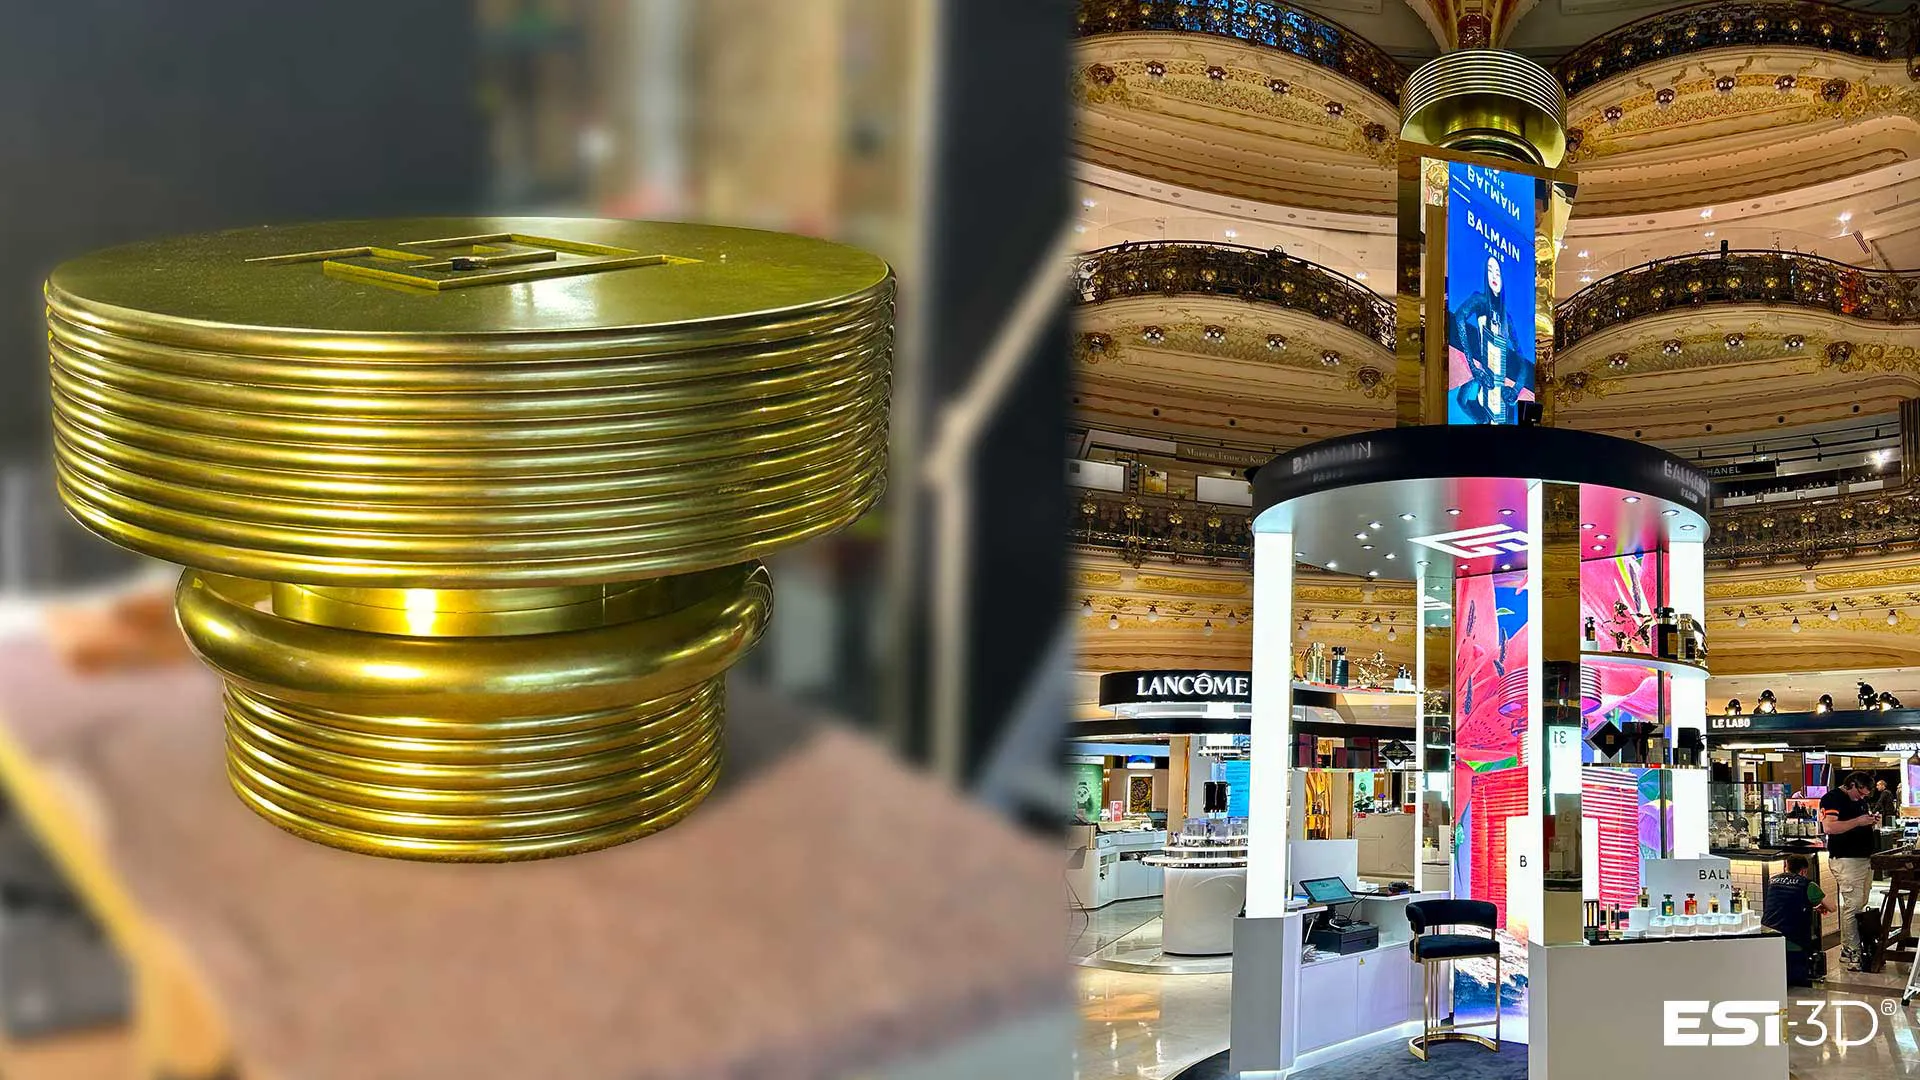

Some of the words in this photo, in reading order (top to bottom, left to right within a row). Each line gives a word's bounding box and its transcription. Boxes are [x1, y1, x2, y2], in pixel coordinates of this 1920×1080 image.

[1467, 209, 1520, 263] BALMAIN
[1484, 242, 1505, 263] PARIS
[1292, 440, 1371, 475] BALMAIN
[1136, 673, 1249, 696] LANCÔME
[1712, 719, 1724, 729] LE
[1726, 718, 1750, 729] LABO
[1519, 855, 1528, 868] B
